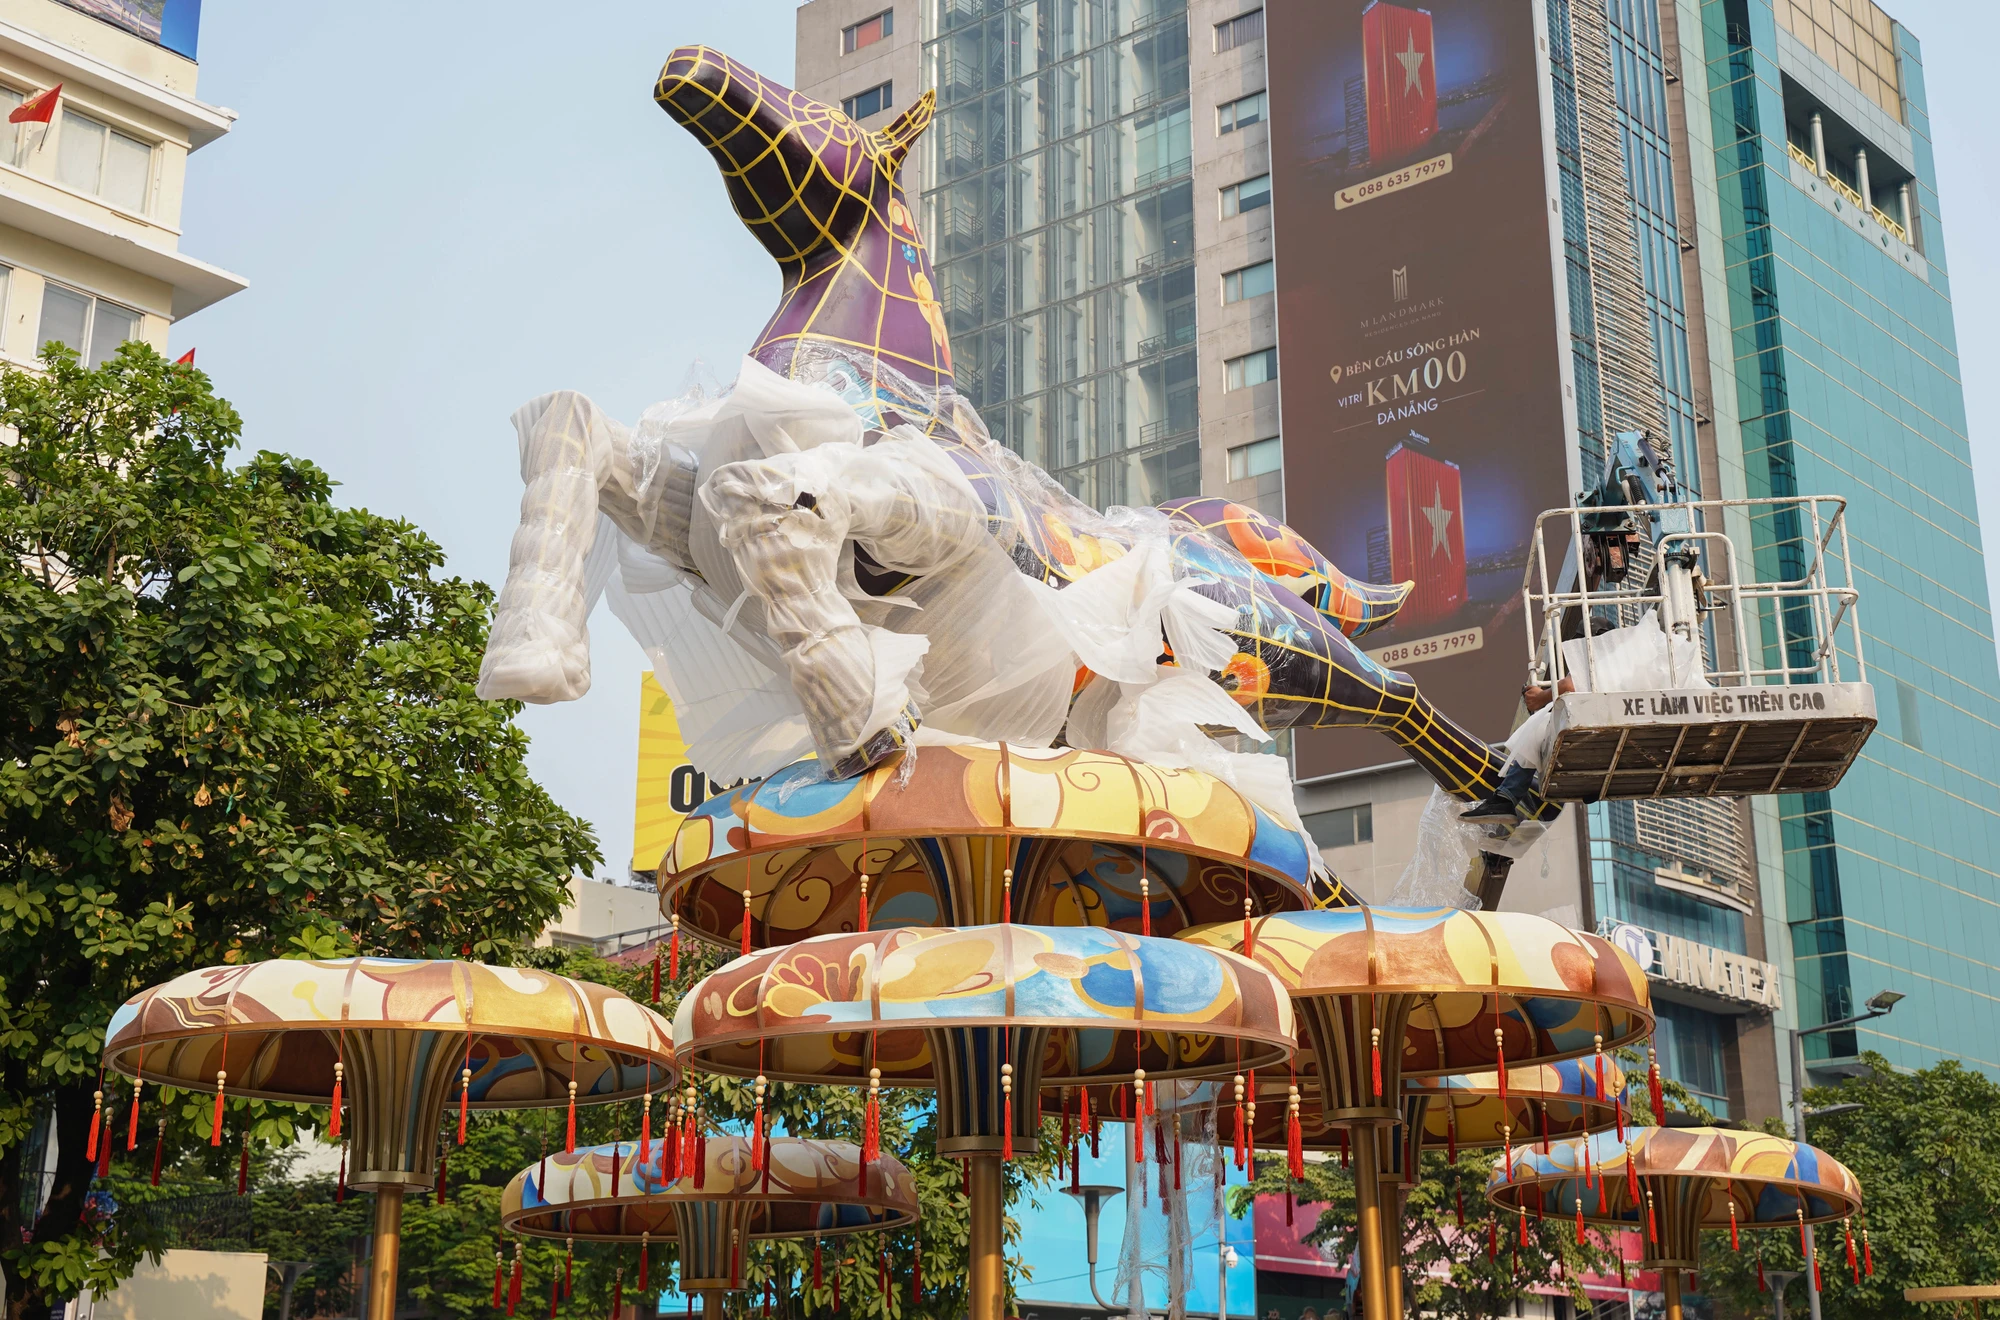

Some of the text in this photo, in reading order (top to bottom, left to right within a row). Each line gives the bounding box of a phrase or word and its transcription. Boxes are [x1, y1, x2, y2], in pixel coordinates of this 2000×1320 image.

[1359, 159, 1446, 197] 088 635 7979
[1373, 296, 1444, 325] LANDMARK
[1406, 338, 1446, 359] SÔNG
[1448, 327, 1480, 346] HÀN
[1377, 397, 1438, 425] ĐÀ NẴNG
[1382, 633, 1476, 663] 088 635 7979
[1622, 690, 1826, 718] XE LÀM VIỆC TRÊN CAO
[1656, 931, 1782, 1010] VINATEX
